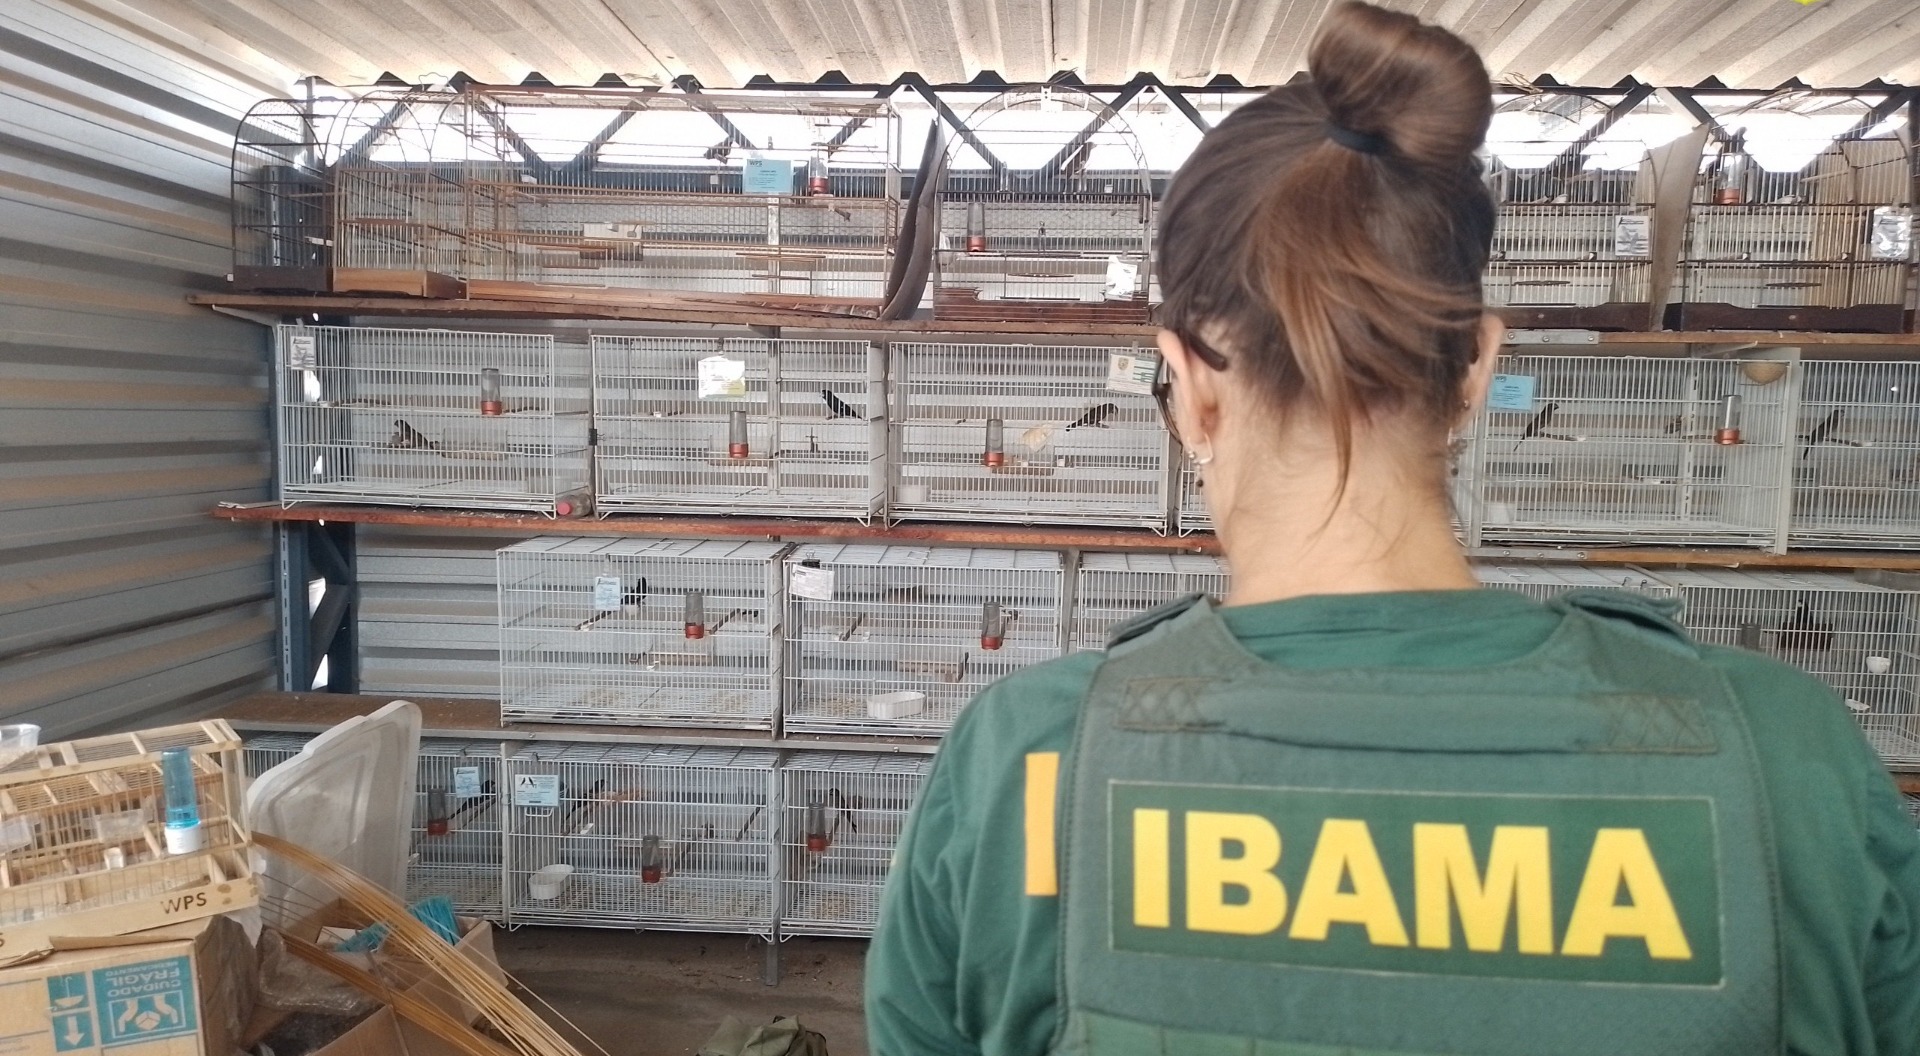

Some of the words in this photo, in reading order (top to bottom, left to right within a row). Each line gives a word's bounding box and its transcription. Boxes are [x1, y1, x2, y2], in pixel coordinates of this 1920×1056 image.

[1133, 808, 1693, 960] IBAMA
[160, 892, 207, 914] WPS
[107, 979, 182, 998] CUIDADO
